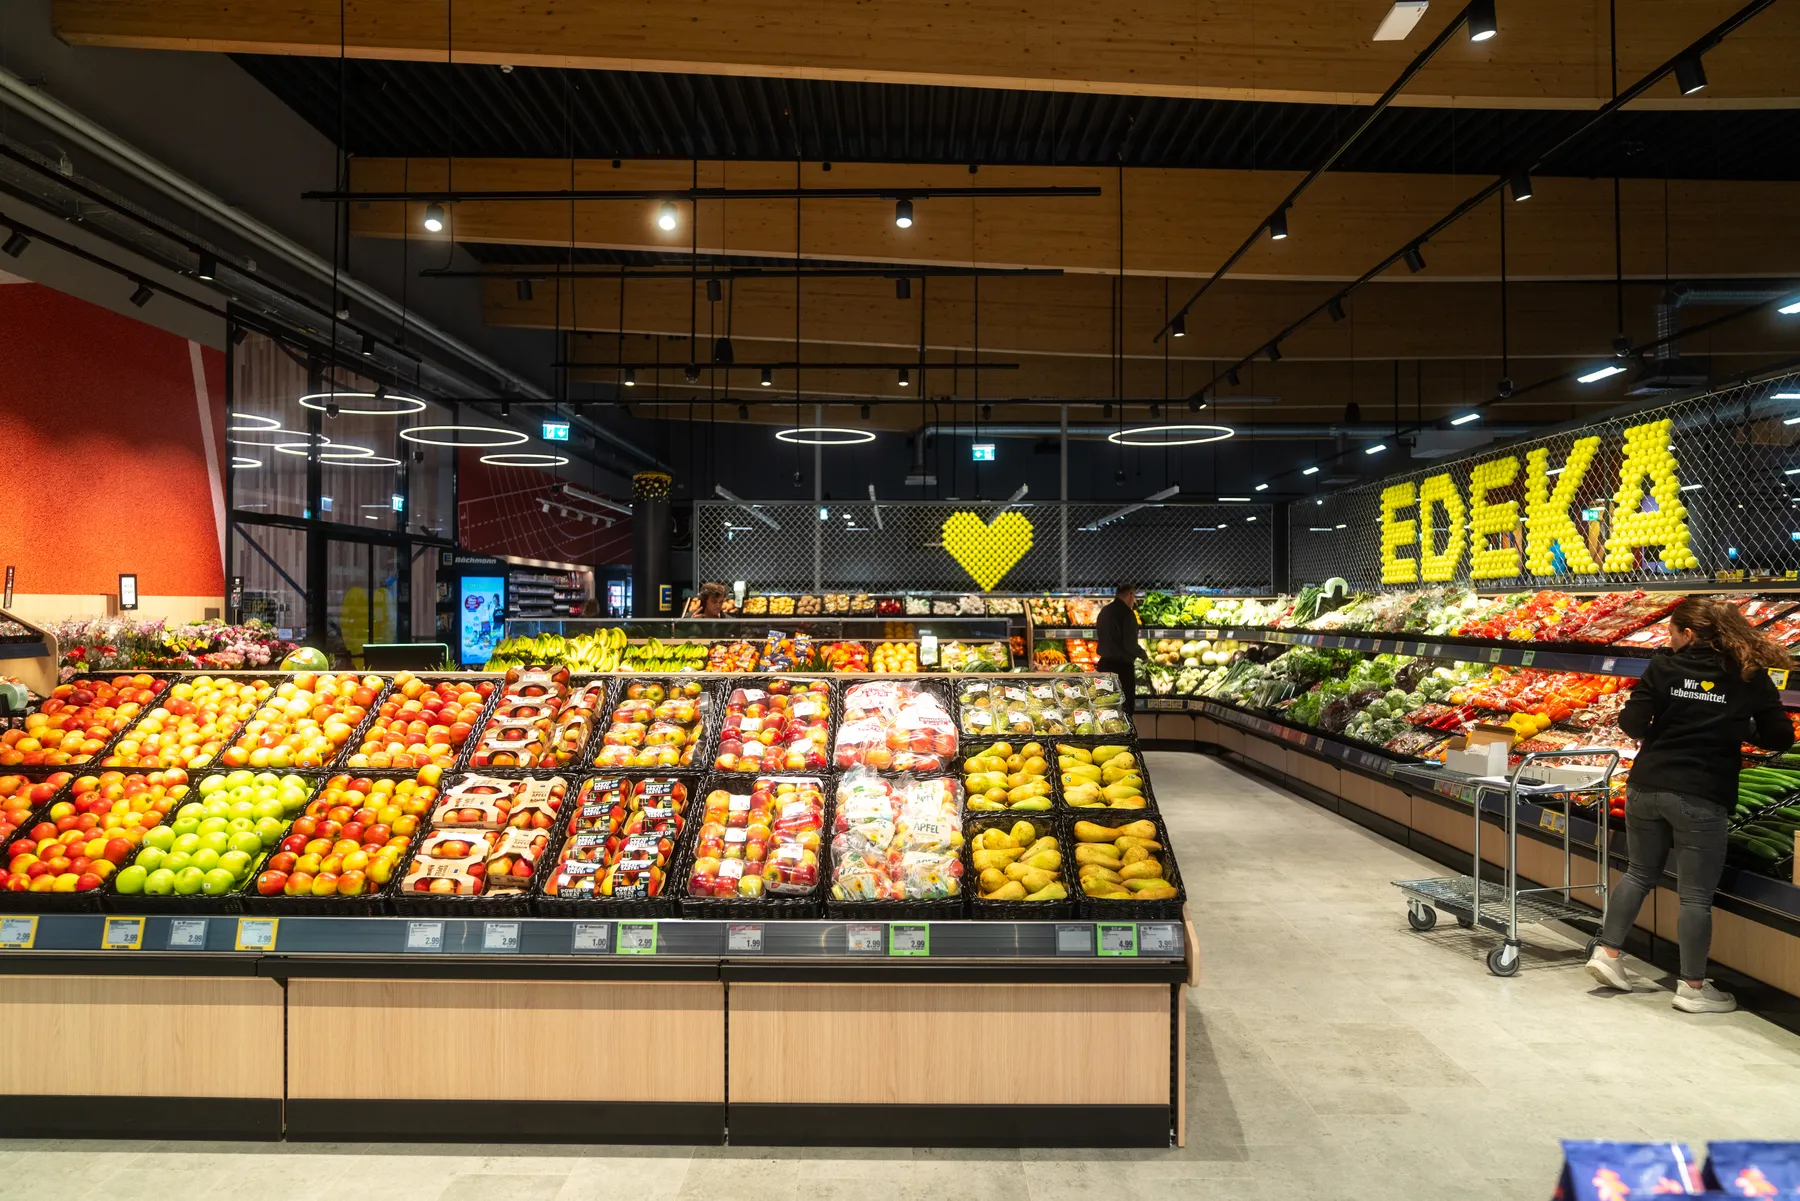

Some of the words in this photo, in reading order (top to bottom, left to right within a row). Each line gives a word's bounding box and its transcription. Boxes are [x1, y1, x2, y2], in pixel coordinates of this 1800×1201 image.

[1381, 418, 1698, 584] EDEKA
[1684, 679, 1699, 689] Wir
[1671, 687, 1726, 703] Lebensmittel.
[16, 932, 30, 941] 2.99
[124, 934, 138, 942] 2.99
[188, 935, 202, 943] 2.99
[257, 935, 272, 943] 2.99
[425, 937, 440, 945] 2.99
[502, 937, 516, 945] 2.99
[592, 938, 606, 946] 1.00
[638, 938, 652, 947] 2.99
[746, 939, 760, 947] 1.99
[866, 940, 880, 948] 2.99
[911, 940, 925, 948] 2.99
[1119, 940, 1133, 948] 4.99
[1158, 940, 1172, 948] 3.99
